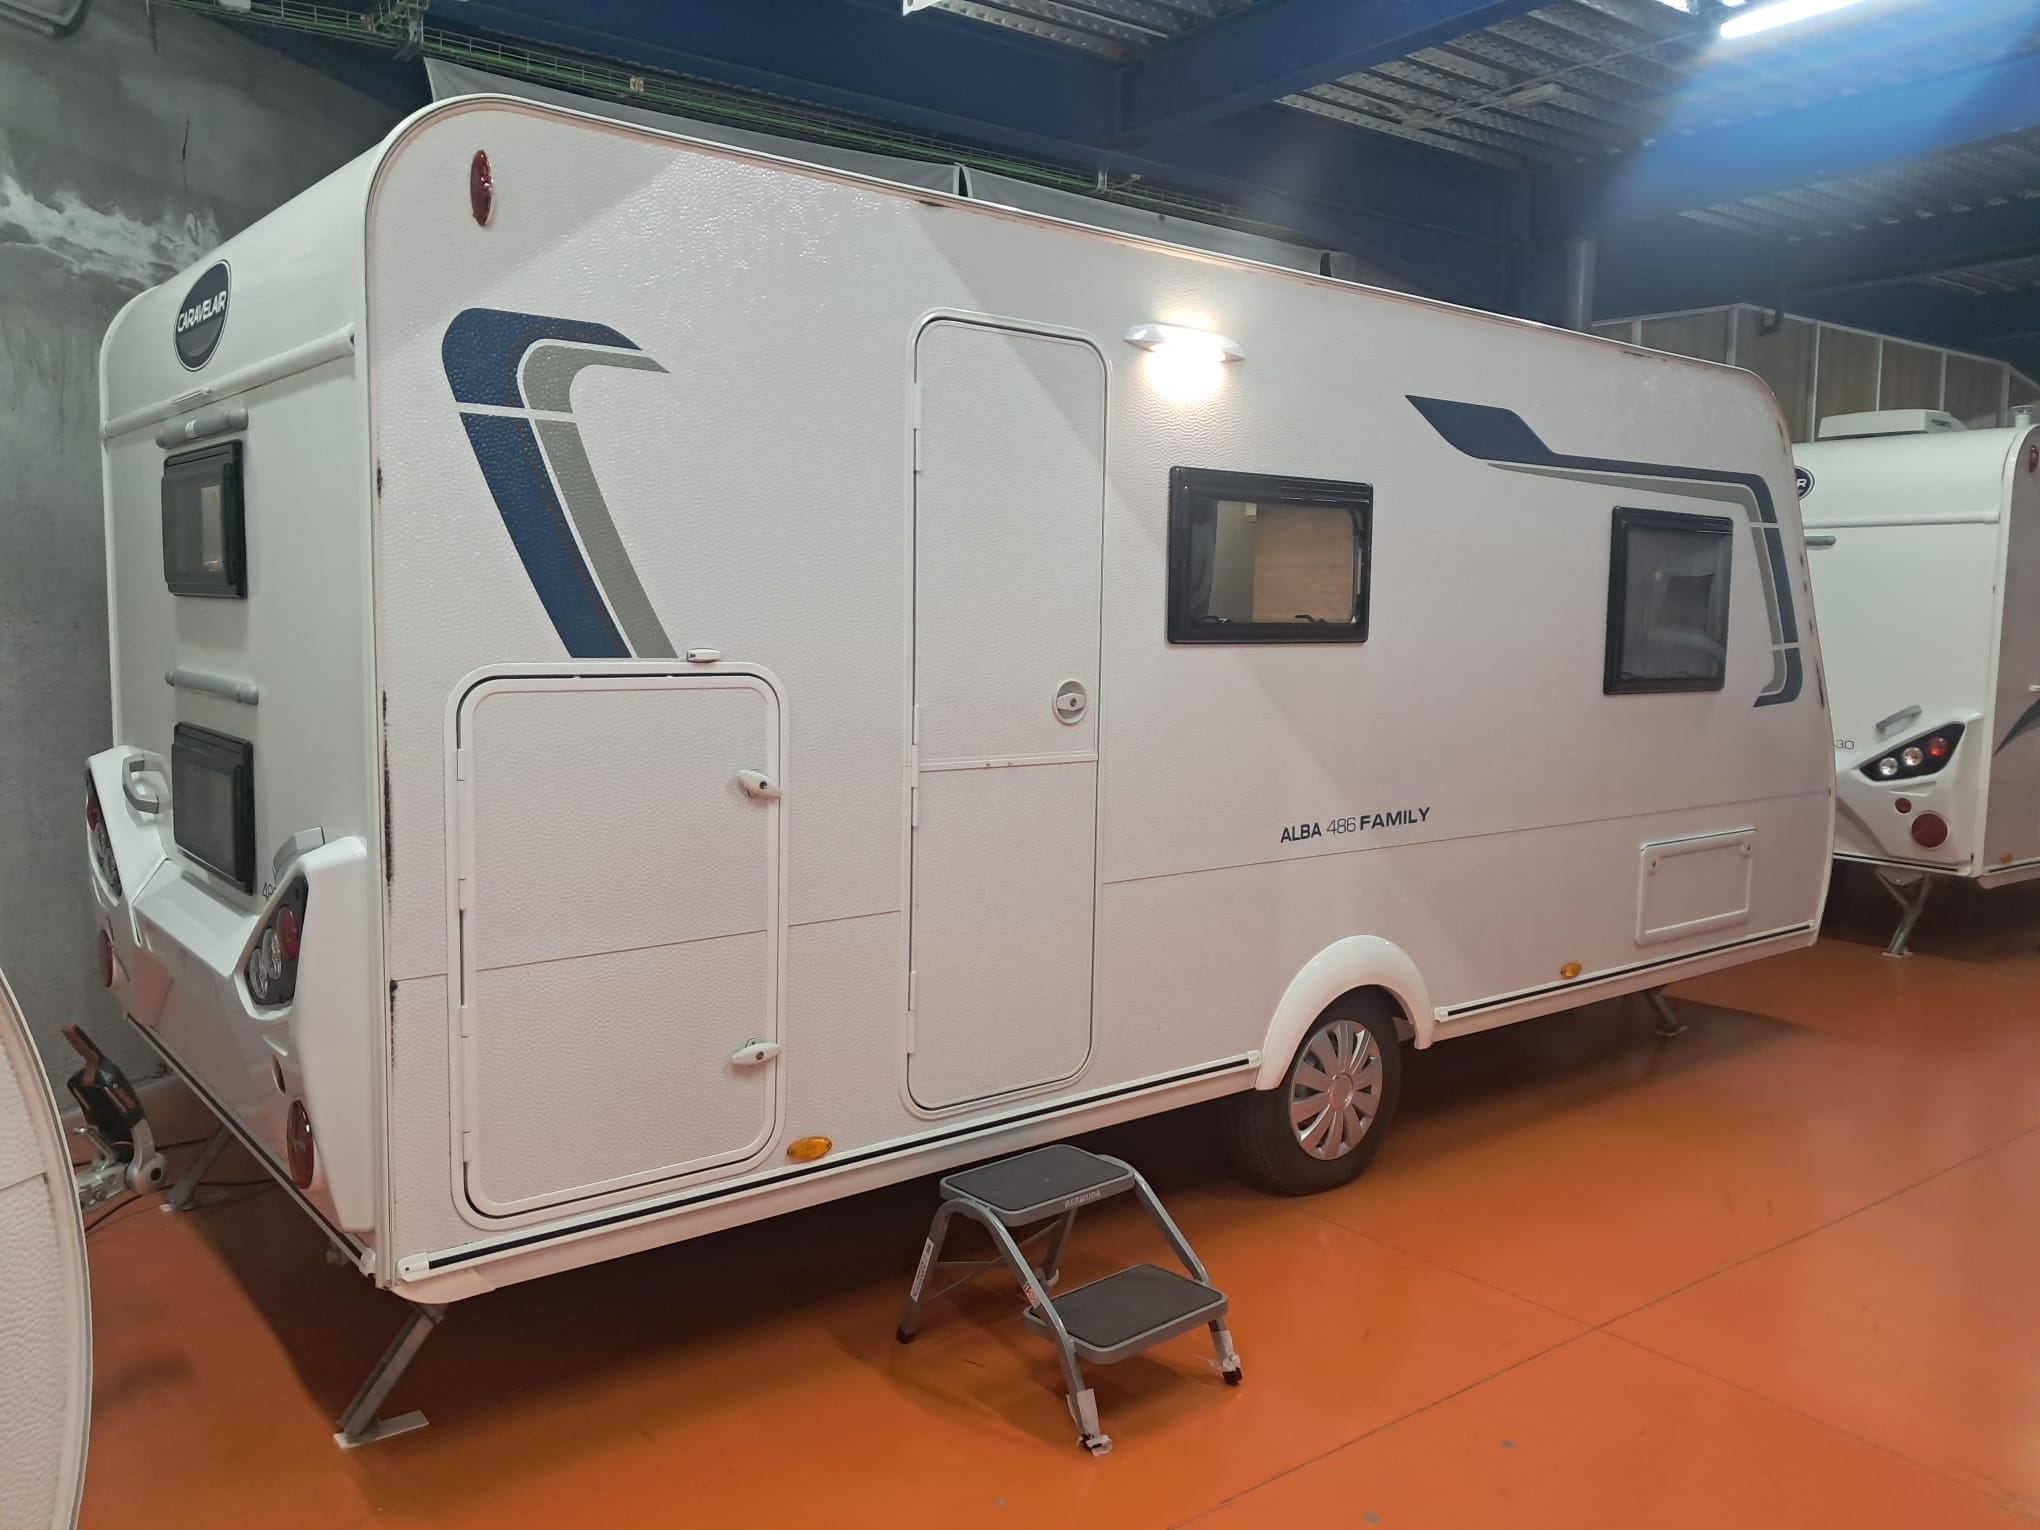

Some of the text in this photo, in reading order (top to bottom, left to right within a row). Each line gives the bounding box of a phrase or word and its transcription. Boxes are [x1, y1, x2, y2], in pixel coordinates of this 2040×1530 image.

[177, 290, 227, 333] CARAVELAIR
[1834, 739, 1855, 750] 30
[1280, 806, 1431, 843] ALBA 486 FAMILY
